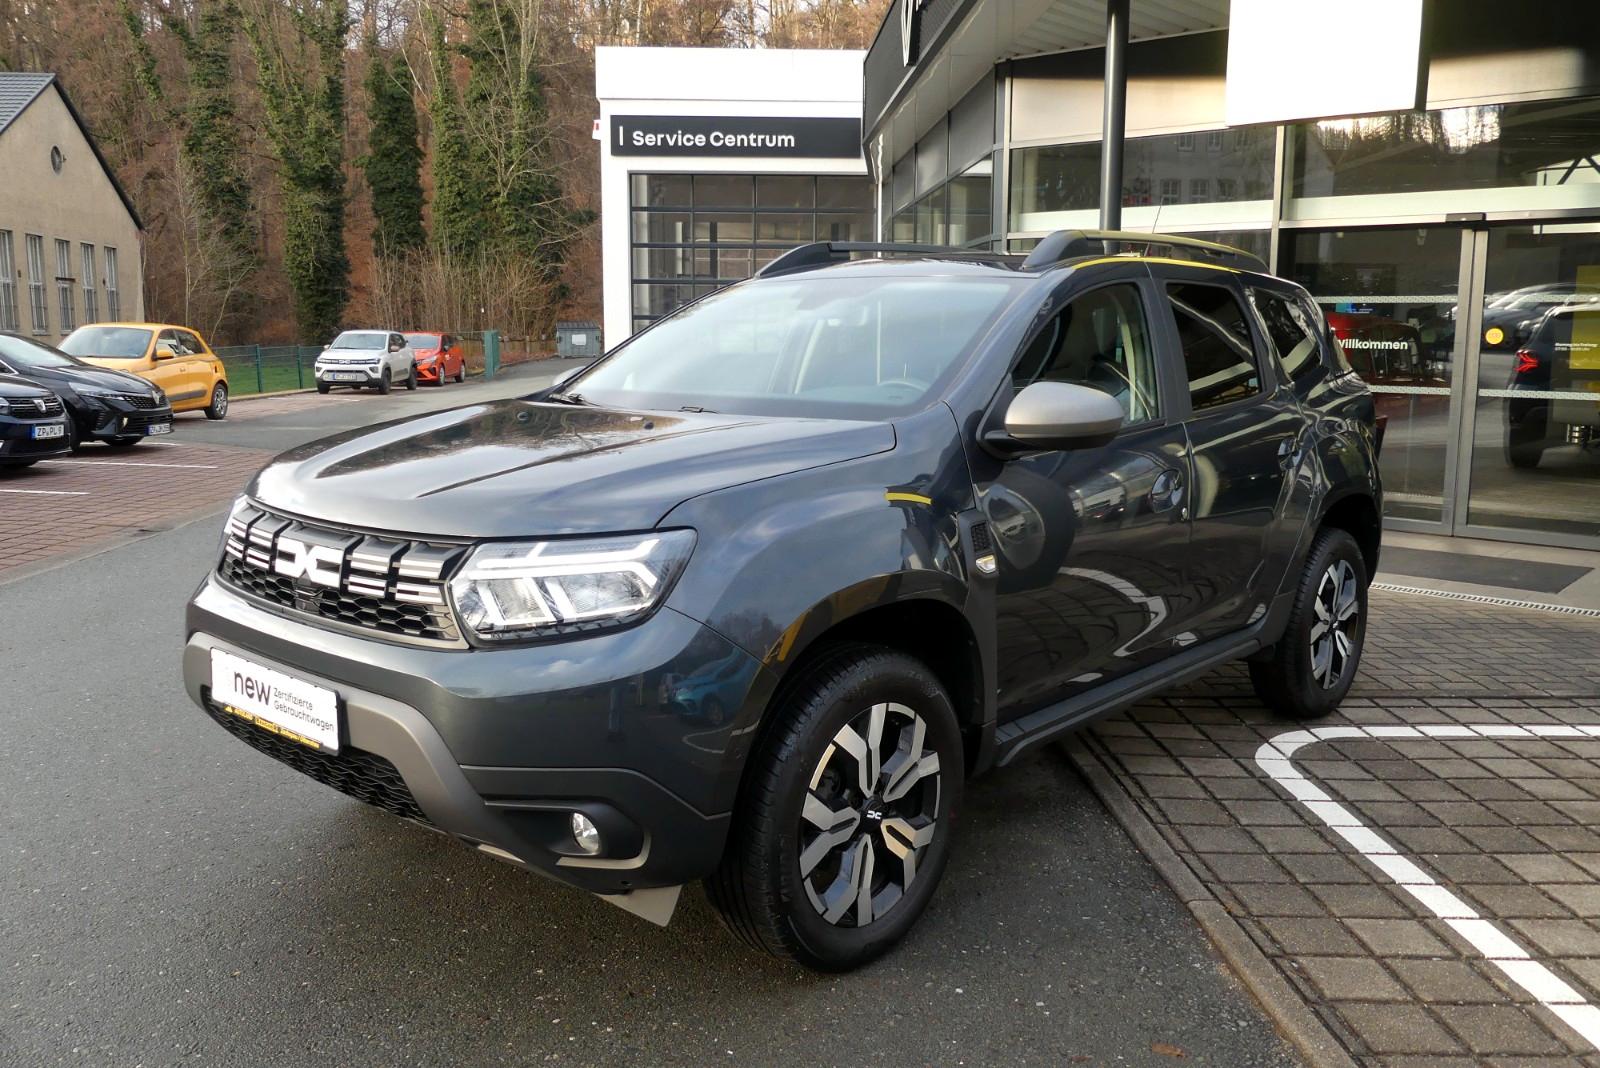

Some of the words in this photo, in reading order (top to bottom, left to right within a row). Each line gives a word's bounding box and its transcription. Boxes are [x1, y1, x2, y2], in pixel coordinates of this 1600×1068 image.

[632, 130, 706, 147] Service
[710, 131, 795, 148] Centrum
[233, 671, 271, 706] new
[273, 687, 313, 711] Zertifizierte
[273, 700, 334, 732] Gebrauchtwagen
